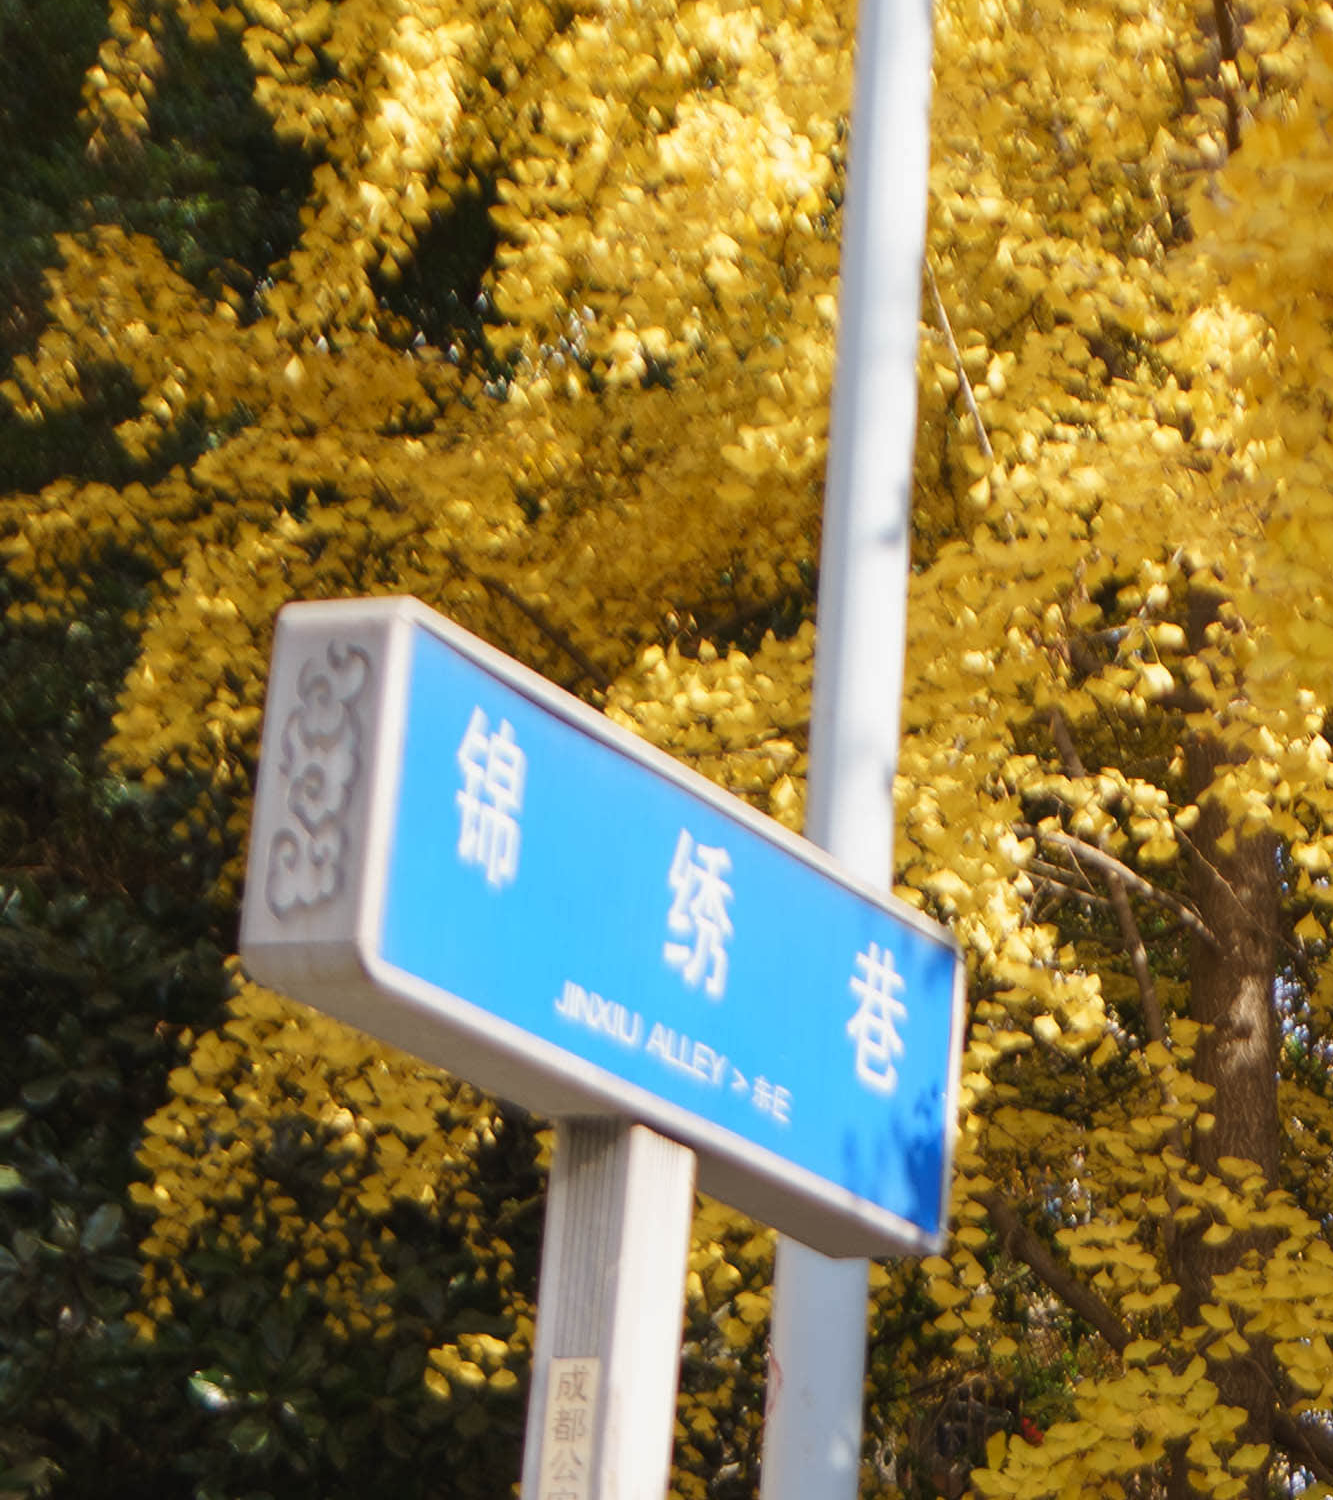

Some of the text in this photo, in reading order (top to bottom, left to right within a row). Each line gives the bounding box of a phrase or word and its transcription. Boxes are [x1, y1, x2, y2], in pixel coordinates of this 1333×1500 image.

[457, 704, 908, 1094] 锦绣巷
[554, 979, 642, 1047] JINXIU
[645, 1021, 728, 1085] ALLEY
